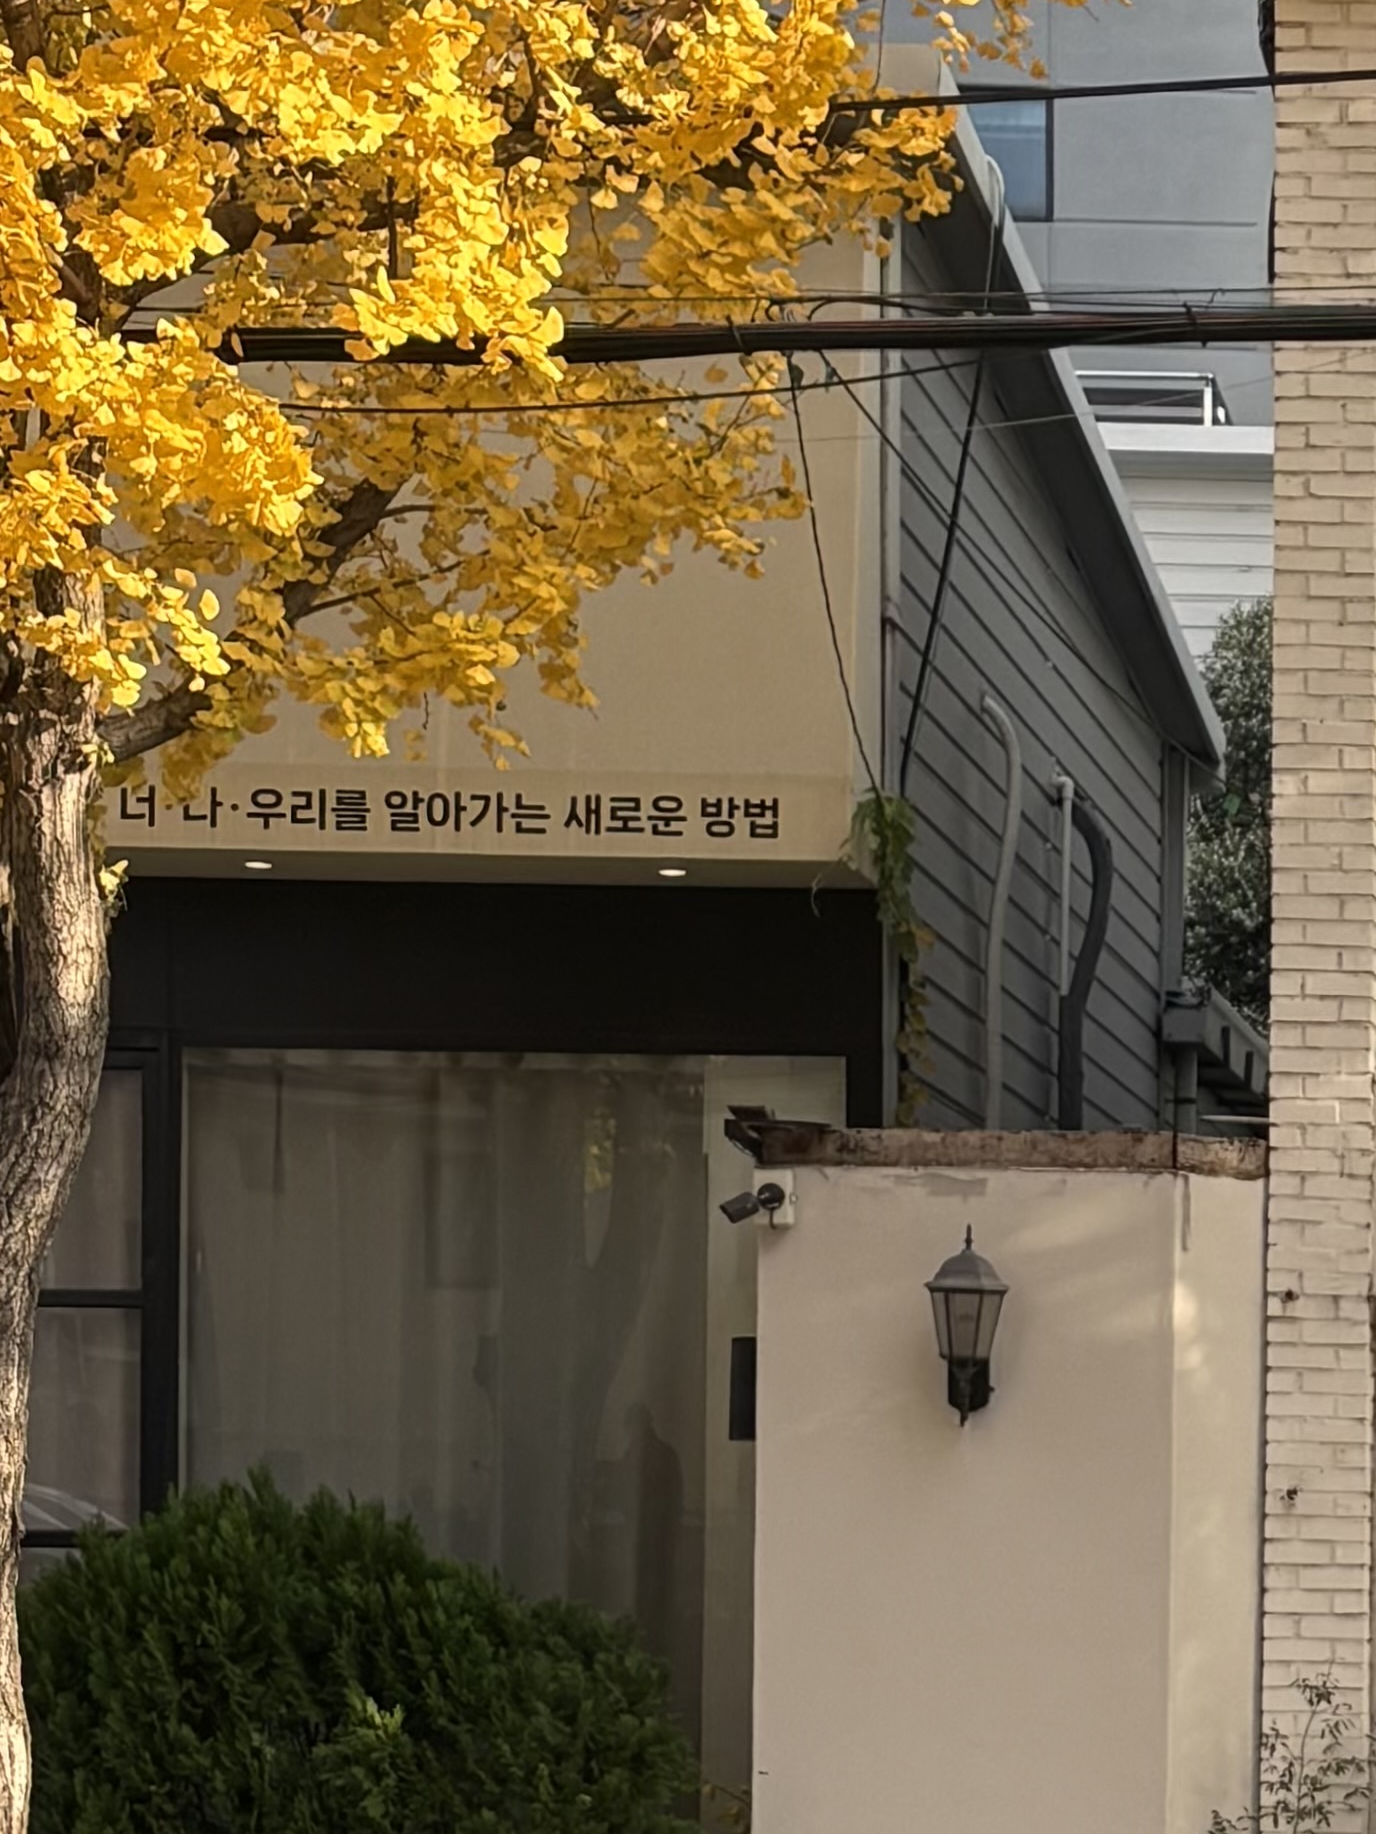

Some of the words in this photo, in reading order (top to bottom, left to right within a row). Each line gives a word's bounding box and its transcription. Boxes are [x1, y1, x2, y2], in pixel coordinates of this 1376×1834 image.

[385, 789, 552, 835] 알아가는
[564, 794, 688, 837] 새로운
[700, 796, 781, 840] 방법
